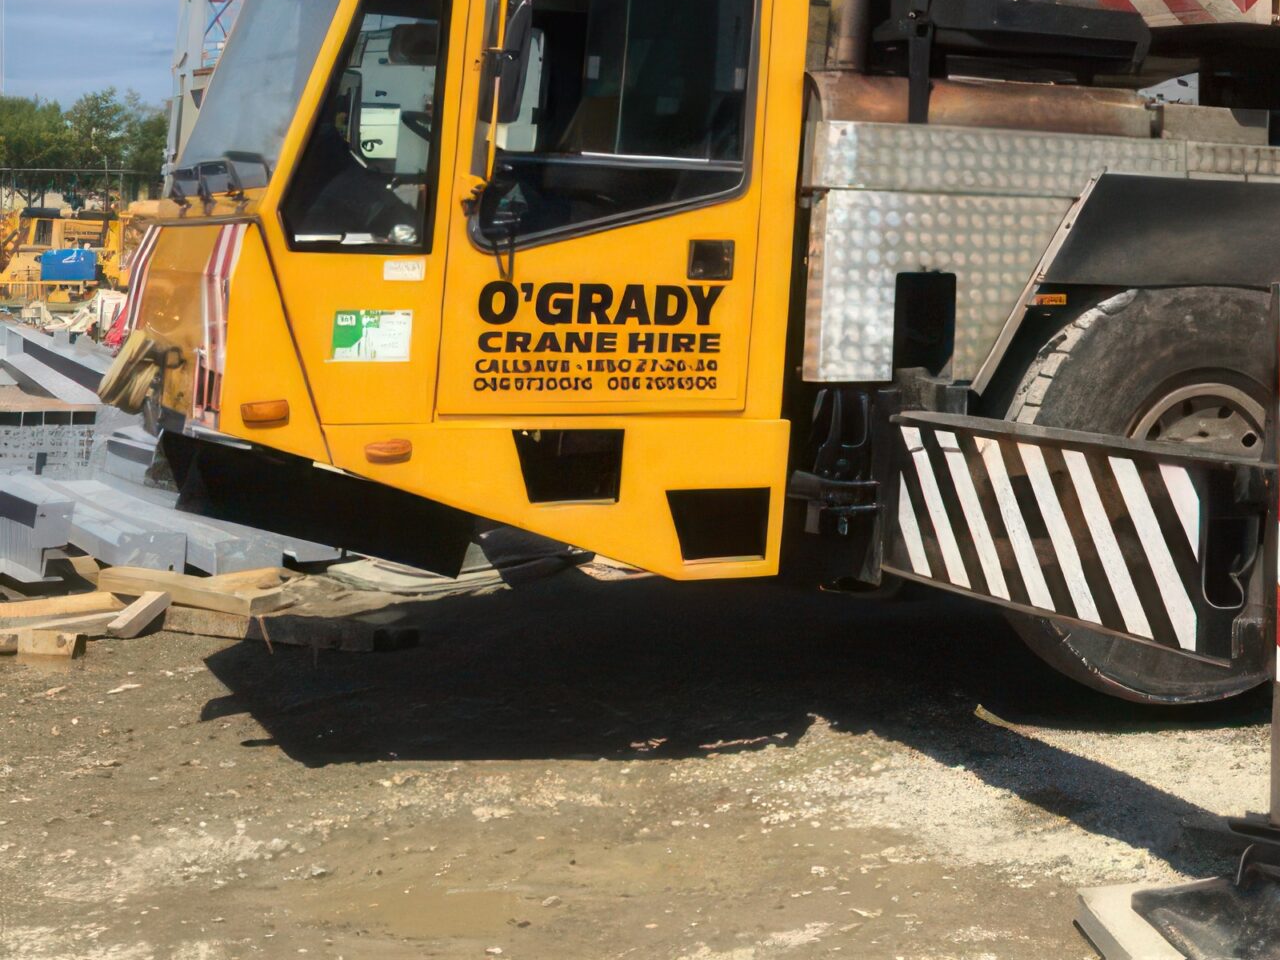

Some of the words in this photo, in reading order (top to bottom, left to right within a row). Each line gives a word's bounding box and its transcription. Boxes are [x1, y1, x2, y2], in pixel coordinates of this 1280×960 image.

[478, 281, 725, 326] O'GRADY
[478, 331, 617, 354] CRANE
[628, 332, 721, 354] HIRE
